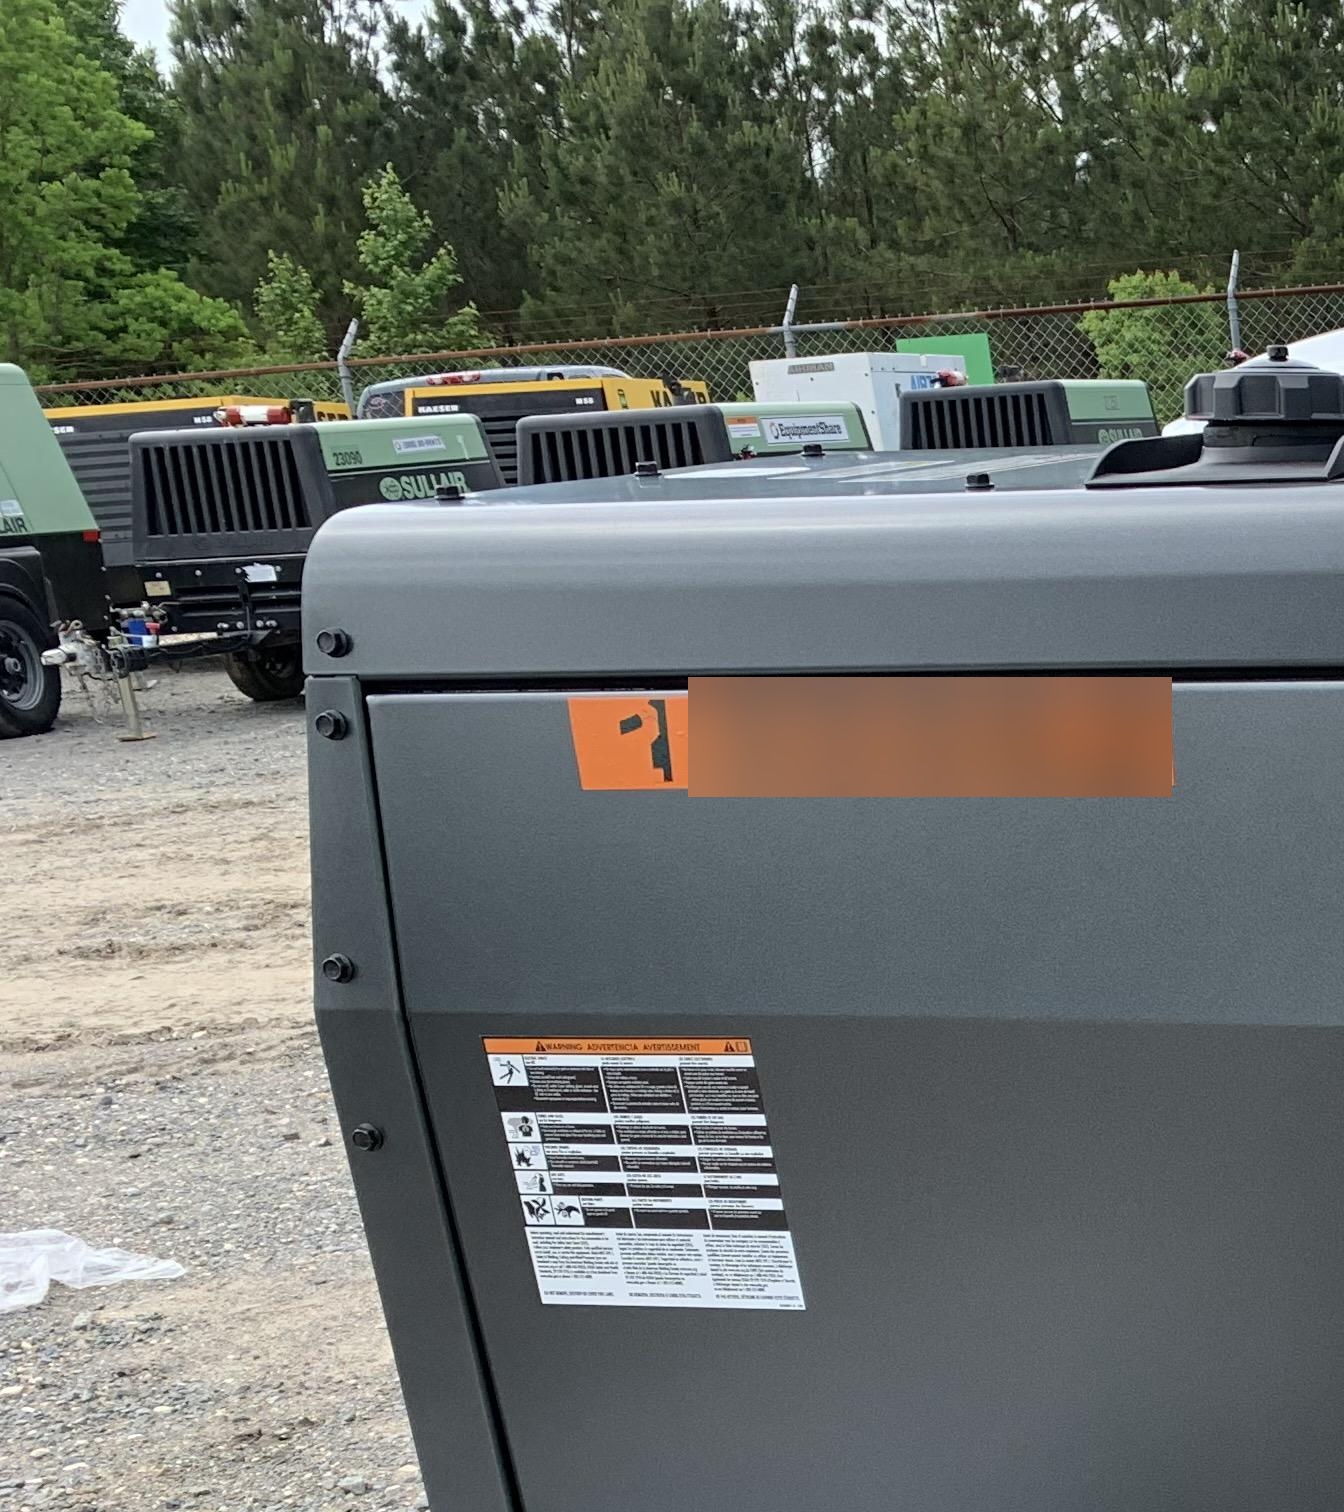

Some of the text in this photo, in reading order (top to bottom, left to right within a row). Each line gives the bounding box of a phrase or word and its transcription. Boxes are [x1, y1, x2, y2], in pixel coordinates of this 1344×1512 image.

[418, 404, 459, 413] KAESER
[779, 421, 843, 440] EquipmentShare
[333, 450, 363, 466] 23090
[400, 471, 470, 500] SULLAIR
[546, 1043, 582, 1051] WARNING
